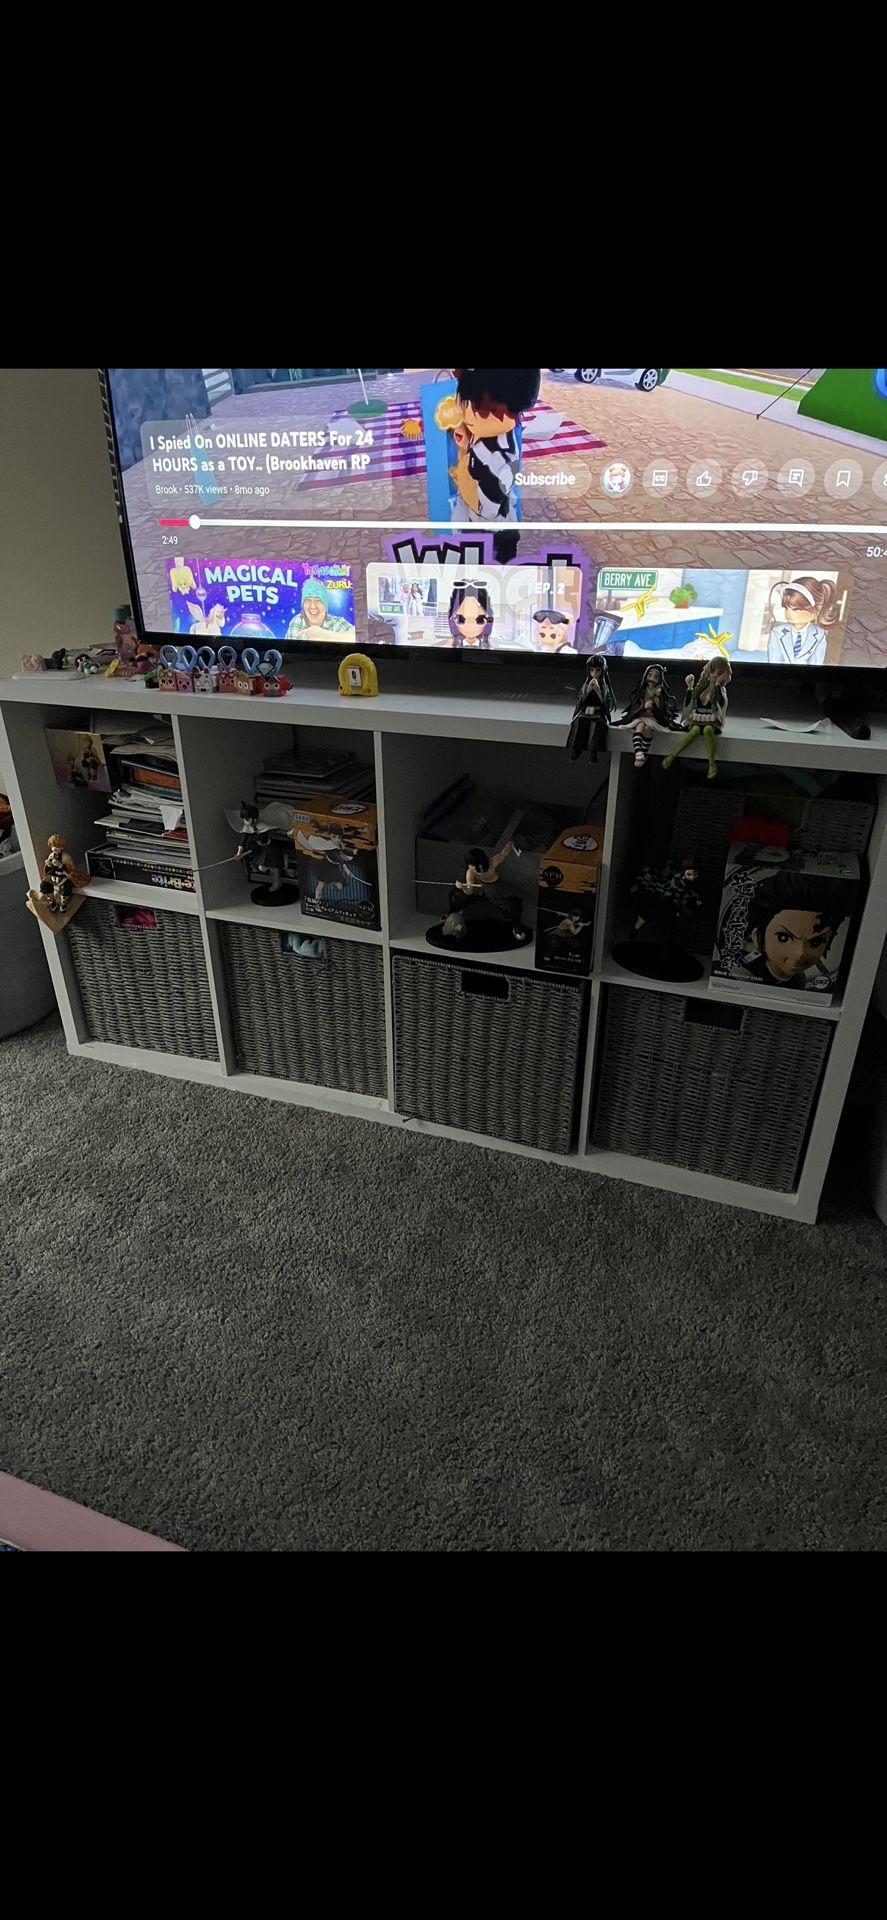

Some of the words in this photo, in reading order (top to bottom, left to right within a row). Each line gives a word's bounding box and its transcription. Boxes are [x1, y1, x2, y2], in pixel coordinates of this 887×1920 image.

[149, 435, 155, 450] I
[157, 435, 192, 453] Spied
[194, 434, 213, 449] On
[215, 432, 267, 449] ONLINE
[270, 431, 326, 447] DATERS
[329, 430, 352, 446] For
[355, 429, 374, 446] 24
[152, 457, 198, 472] HOURS
[201, 460, 215, 472] as
[217, 460, 225, 472] a
[227, 456, 263, 471] TOY..
[265, 453, 347, 474] (Brookhaven
[350, 454, 371, 470] RP
[514, 471, 576, 486] Subscribe
[155, 484, 178, 494] Brook
[184, 484, 205, 494] 537K
[205, 485, 228, 494] views
[234, 484, 252, 494] 8mo
[254, 486, 270, 496] ago
[161, 535, 178, 545] 2:49
[204, 564, 298, 588] MAGICAL
[604, 572, 633, 587] BERRY
[226, 584, 279, 605] PETS
[535, 582, 554, 595] EP.
[556, 582, 565, 595] 2
